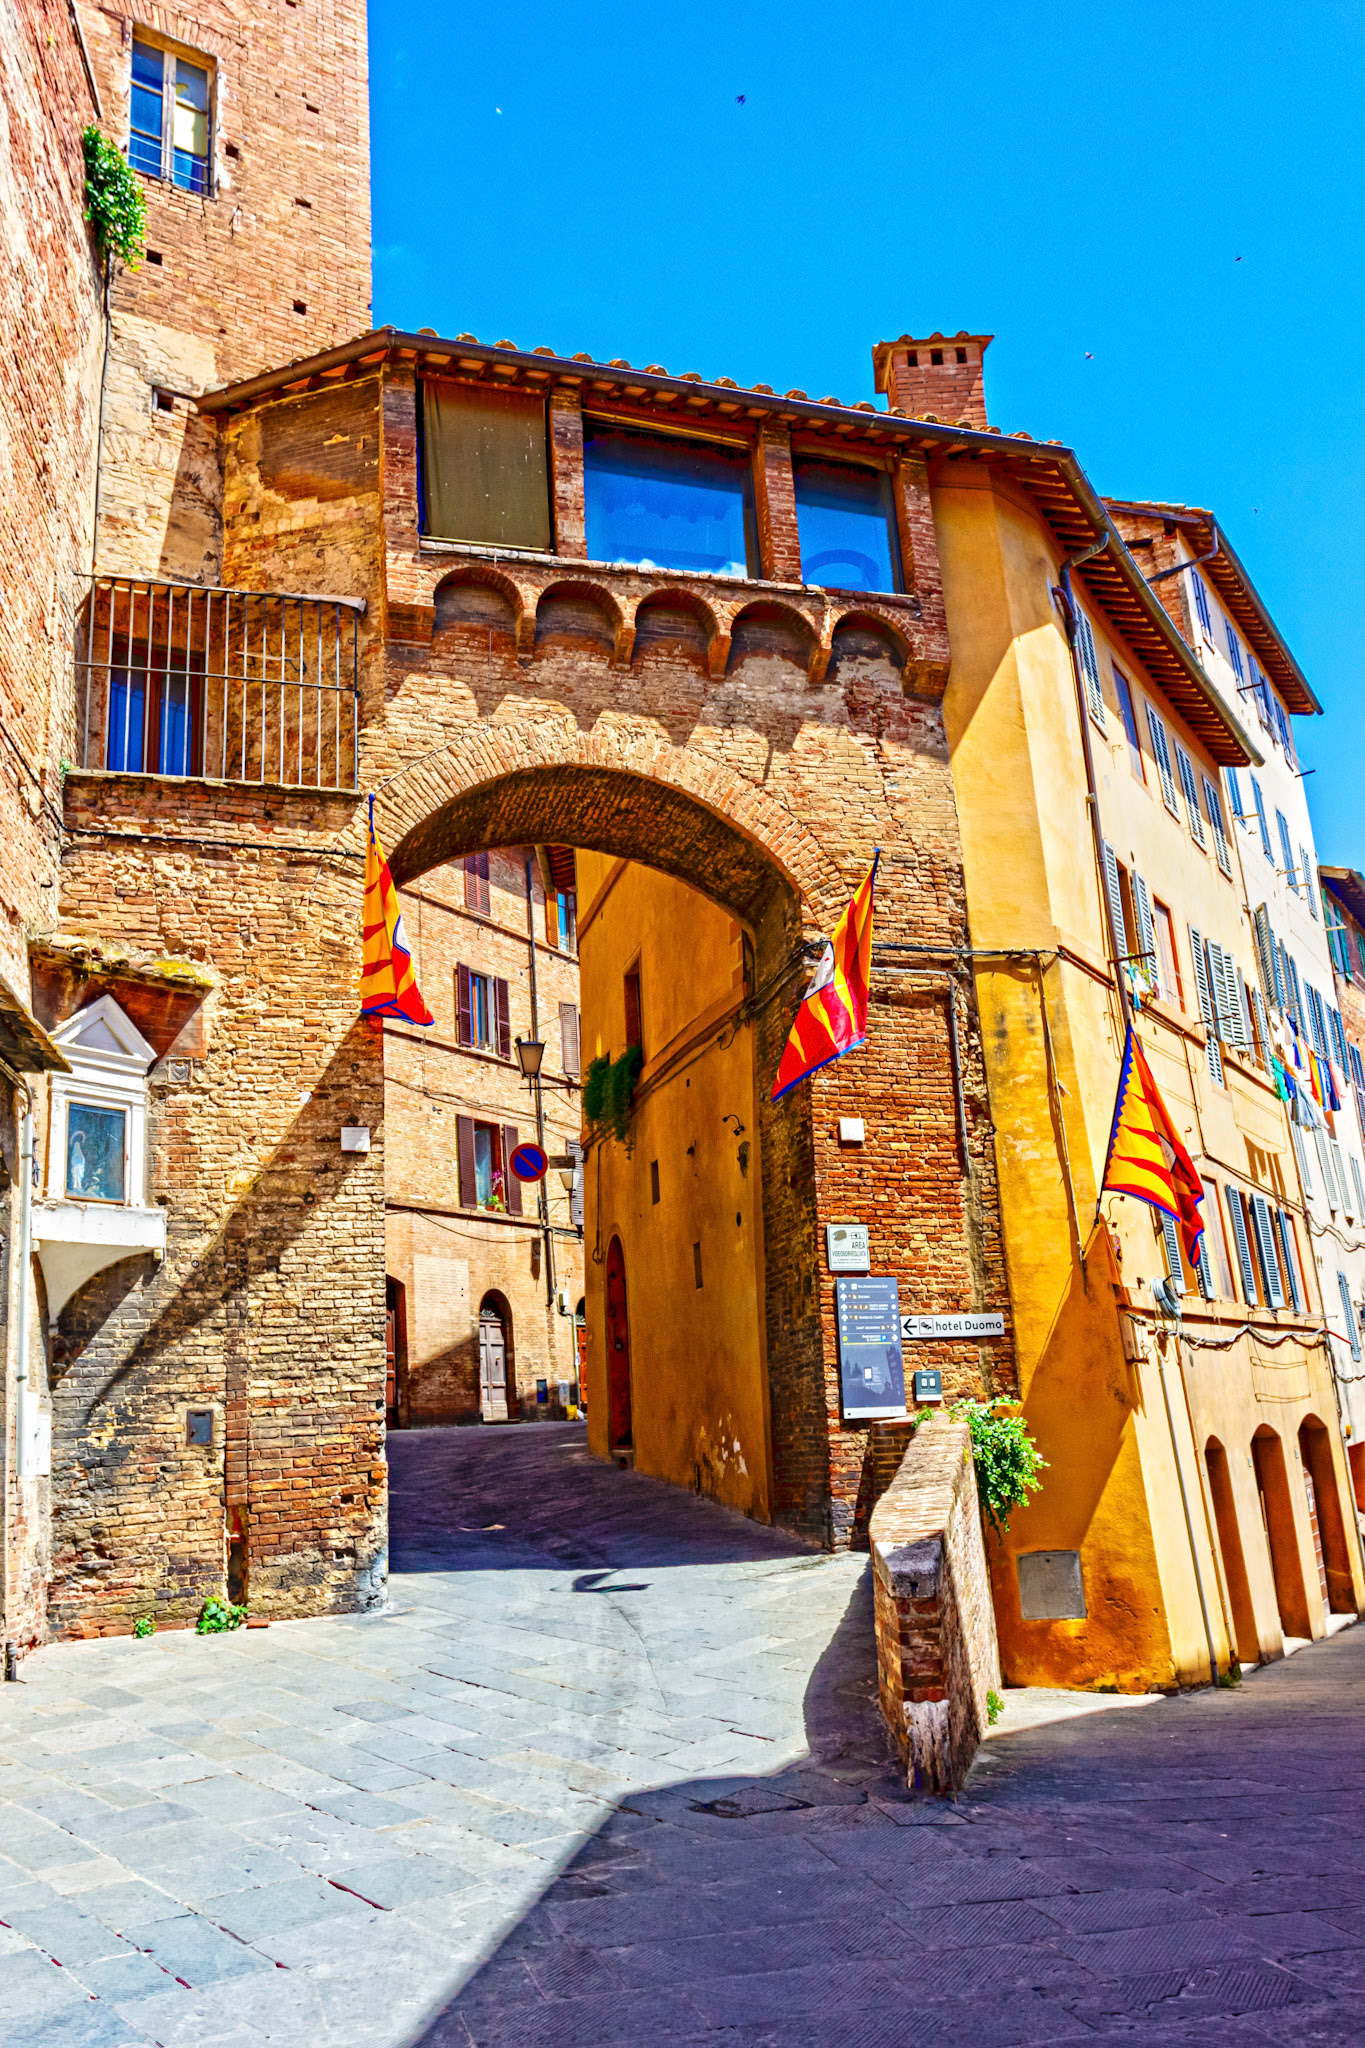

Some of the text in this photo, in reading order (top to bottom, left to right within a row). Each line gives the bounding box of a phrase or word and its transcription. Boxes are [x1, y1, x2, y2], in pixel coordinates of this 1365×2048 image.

[851, 1241, 866, 1250] AREA
[935, 1321, 1002, 1331] hotel Duomo
